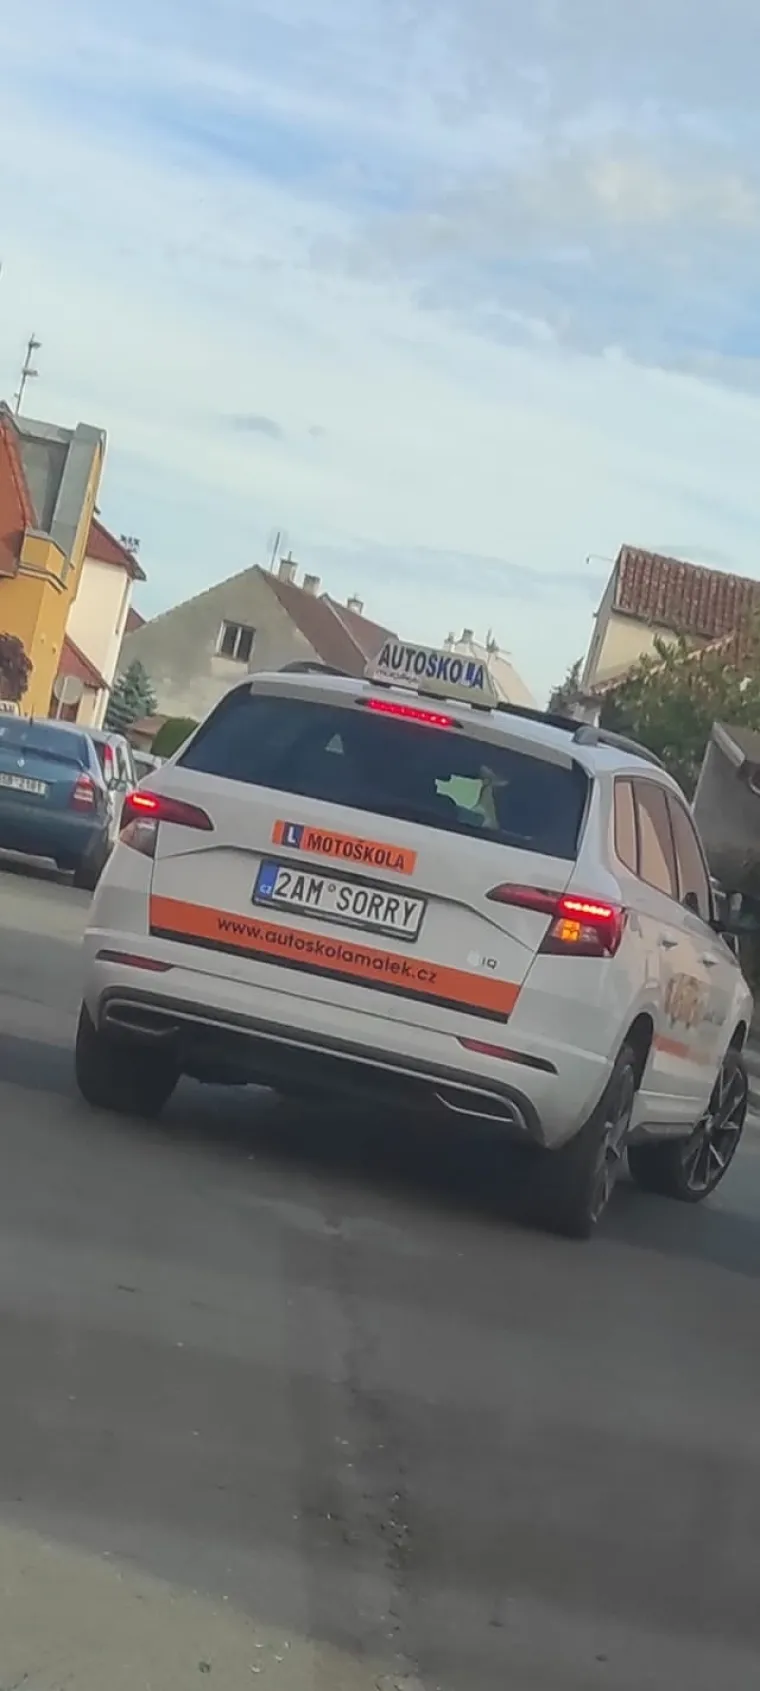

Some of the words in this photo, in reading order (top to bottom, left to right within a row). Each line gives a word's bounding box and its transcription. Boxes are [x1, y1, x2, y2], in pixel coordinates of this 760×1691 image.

[307, 833, 405, 870] MOTOŠKOLA
[259, 883, 272, 894] CZ
[217, 917, 437, 984] www.autoskolamalek.cz
